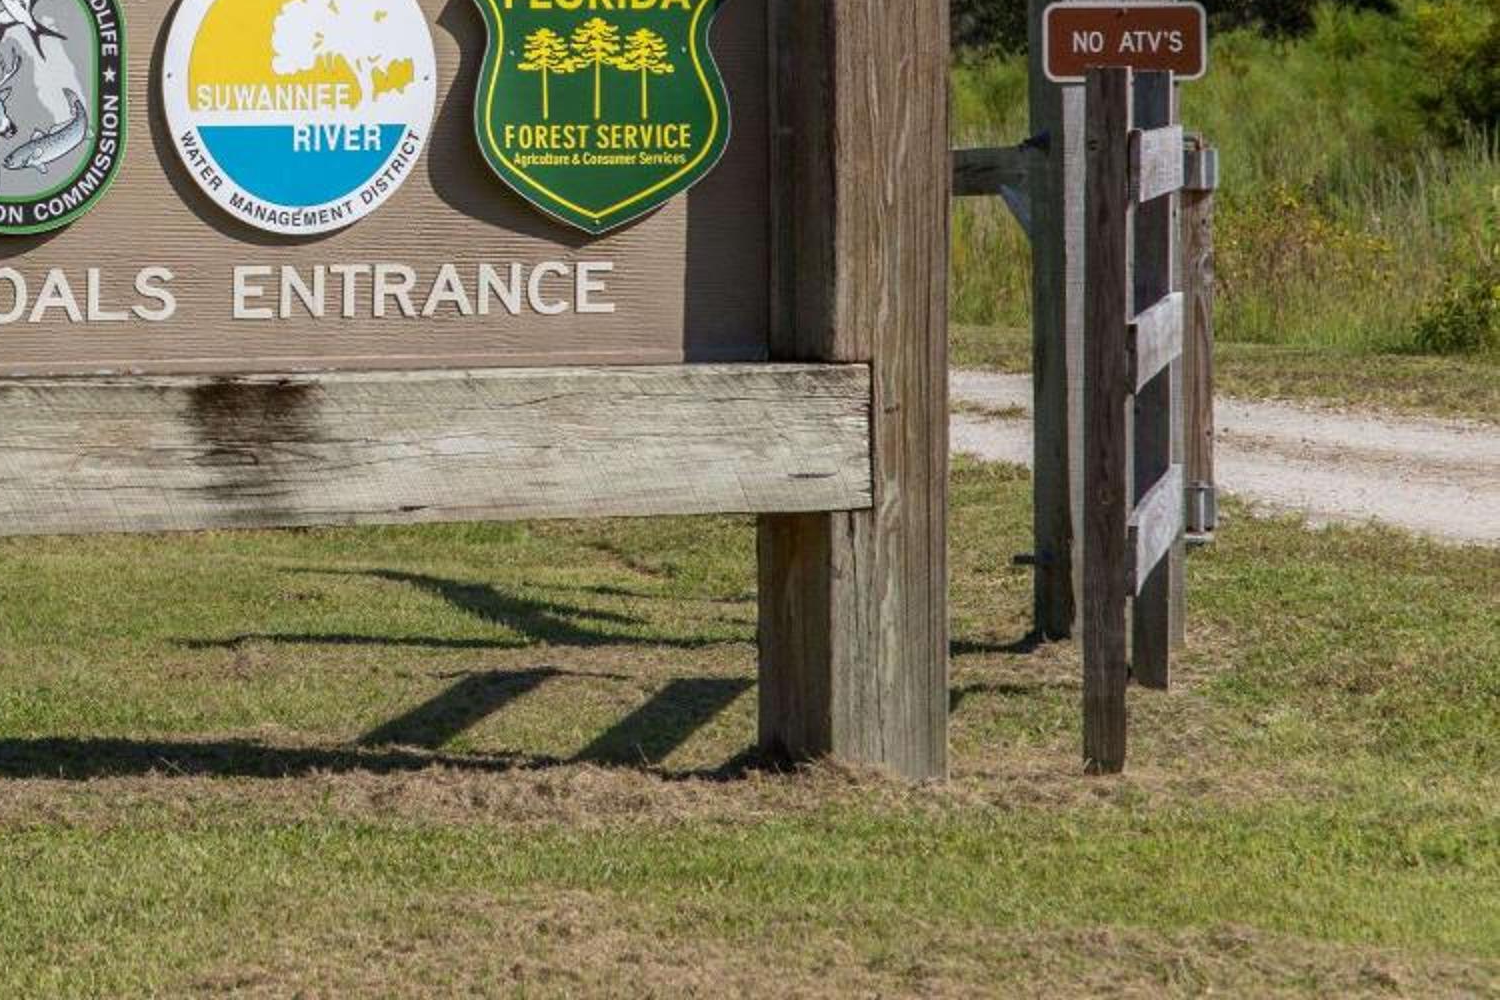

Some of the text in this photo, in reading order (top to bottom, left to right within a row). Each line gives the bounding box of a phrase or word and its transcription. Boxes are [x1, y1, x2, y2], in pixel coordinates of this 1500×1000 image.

[1072, 31, 1183, 53] NO ATV'S
[197, 83, 350, 111] SUWANNEE
[293, 124, 381, 152] RIVER
[505, 124, 692, 149] FOREST SERVICE
[33, 95, 118, 222] COMMISSION
[514, 152, 686, 168] Agriculture & Consumer Services
[180, 129, 420, 227] WATER MANAGEMENT DISTRICT
[232, 261, 615, 320] ENTRANCE
